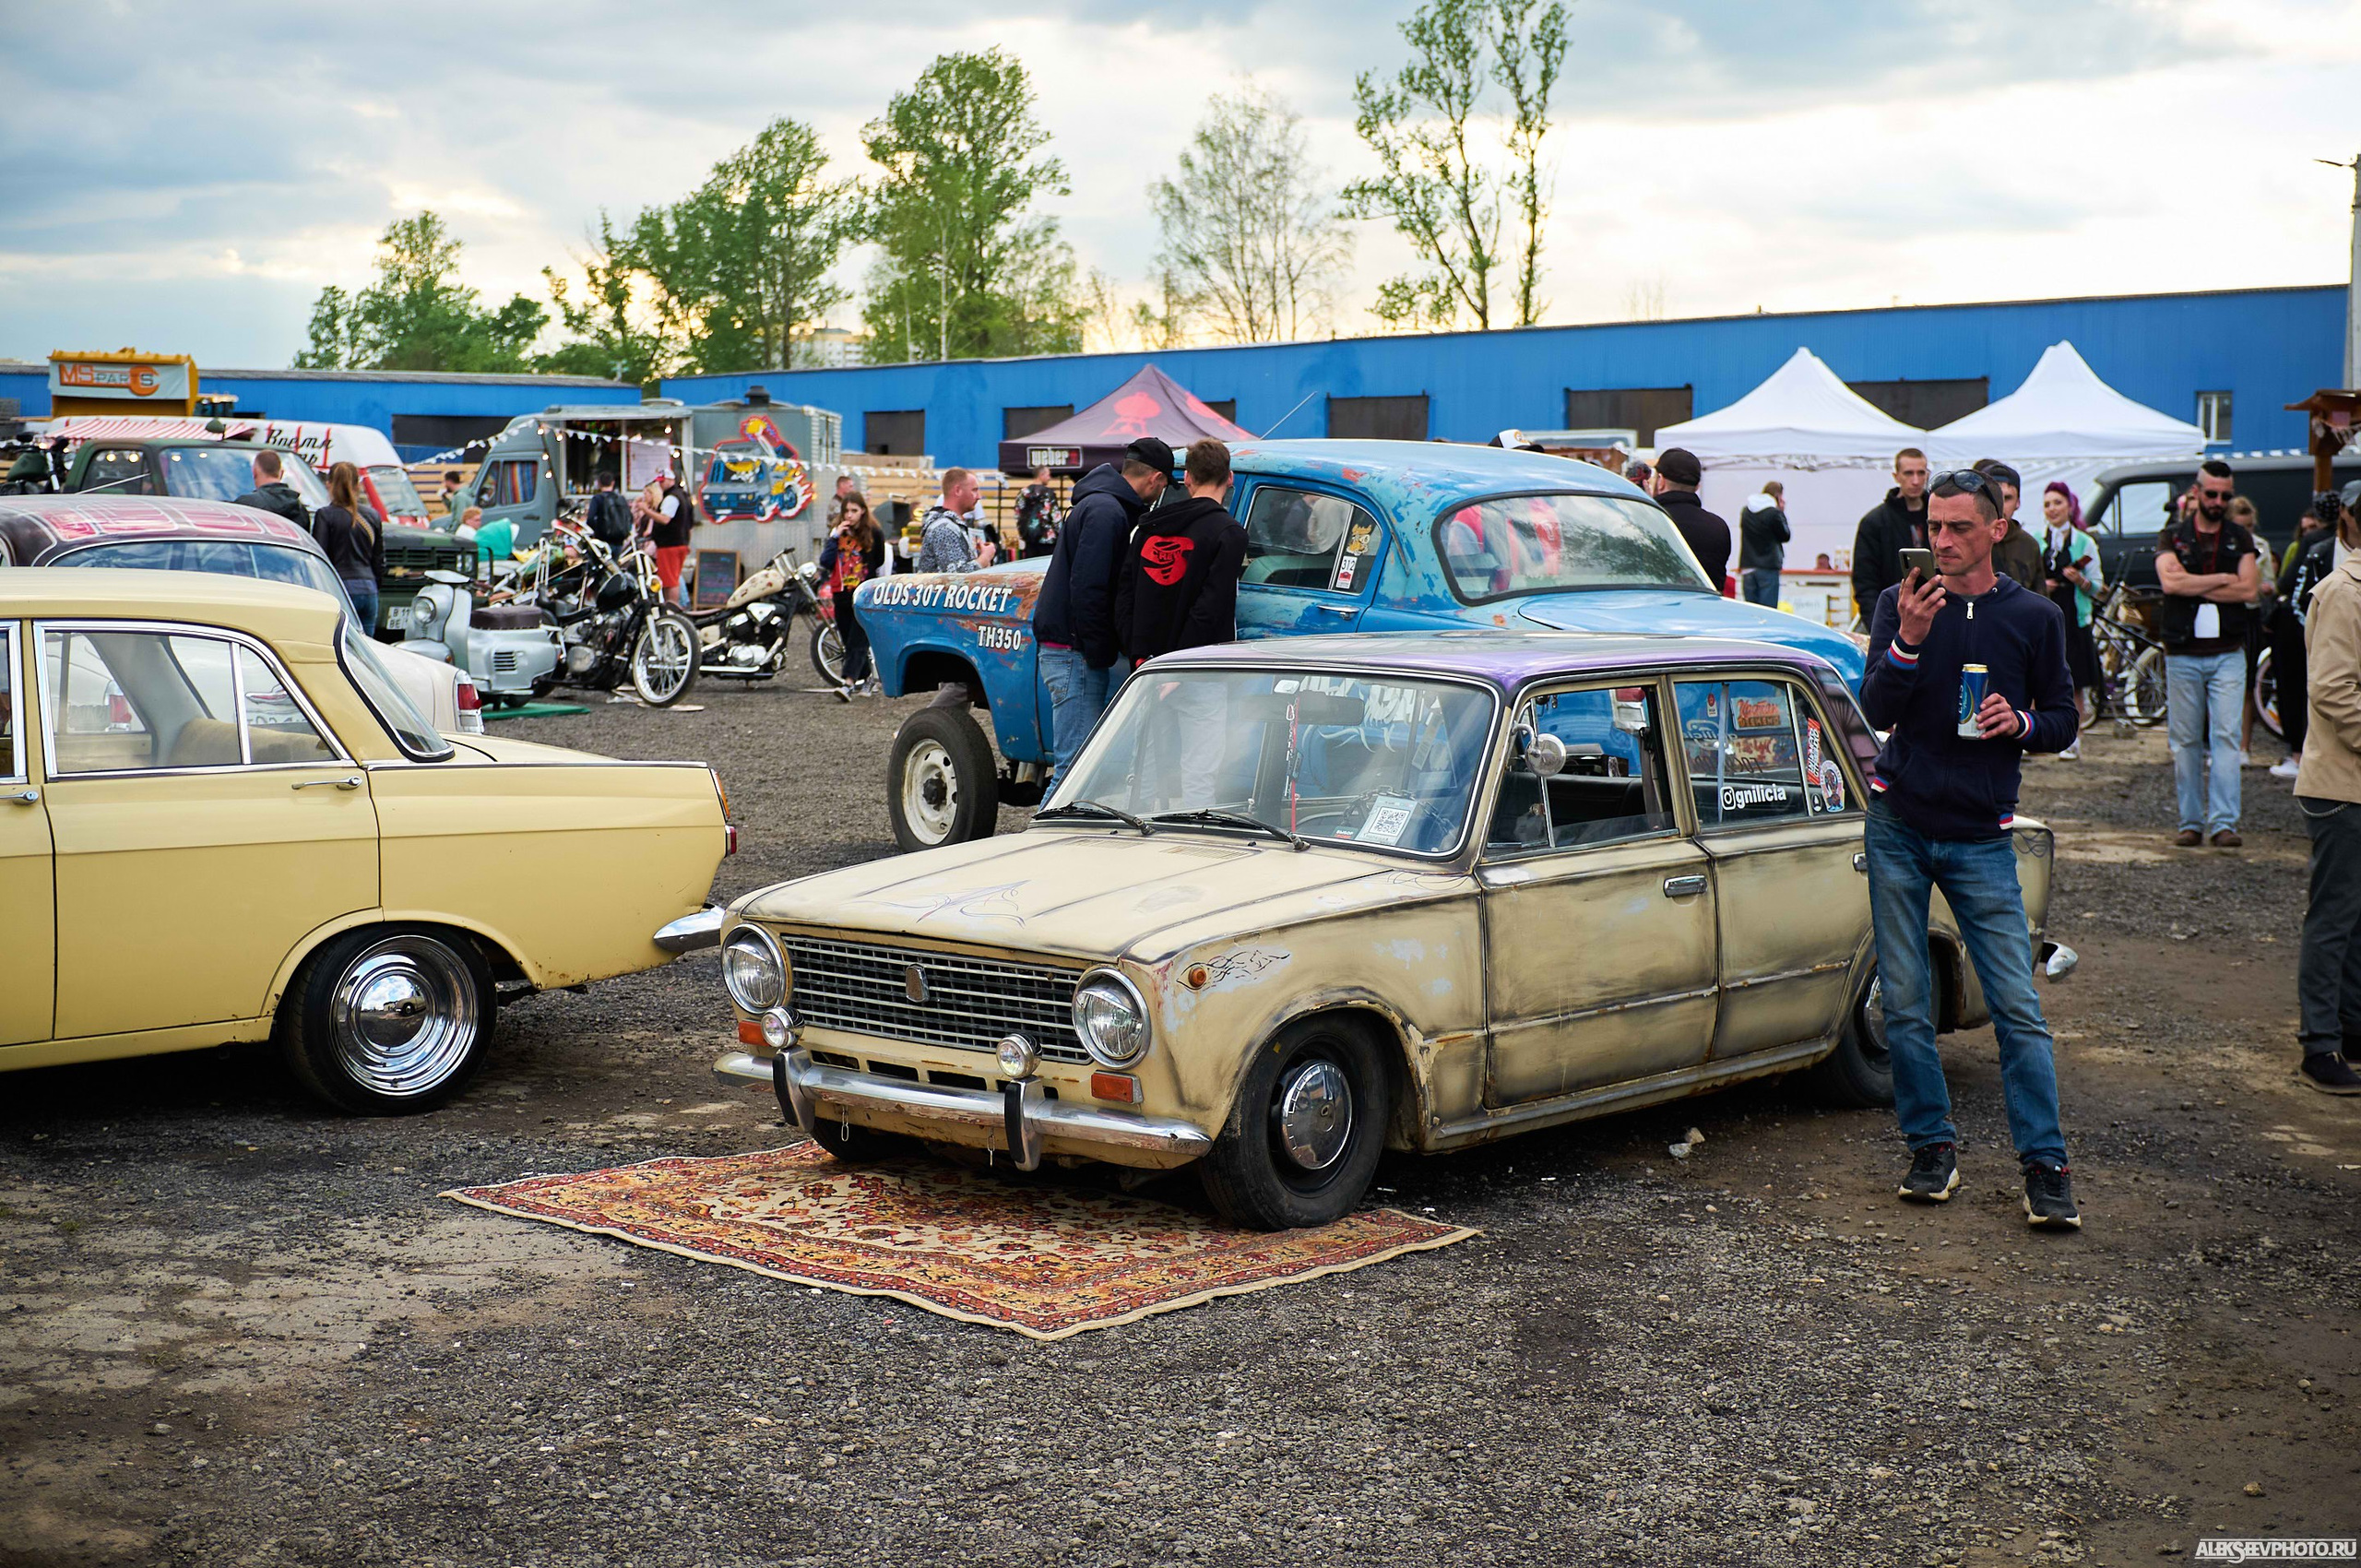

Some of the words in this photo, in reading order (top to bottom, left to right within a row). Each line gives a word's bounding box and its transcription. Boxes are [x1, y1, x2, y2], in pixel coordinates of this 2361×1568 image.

[1031, 447, 1069, 466] weber
[1342, 559, 1356, 571] 312
[872, 582, 913, 606] OLDS
[912, 583, 943, 607] 307
[943, 585, 1014, 612] ROCKET
[978, 625, 1022, 651] TH350
[1735, 783, 1787, 809] gnilicia
